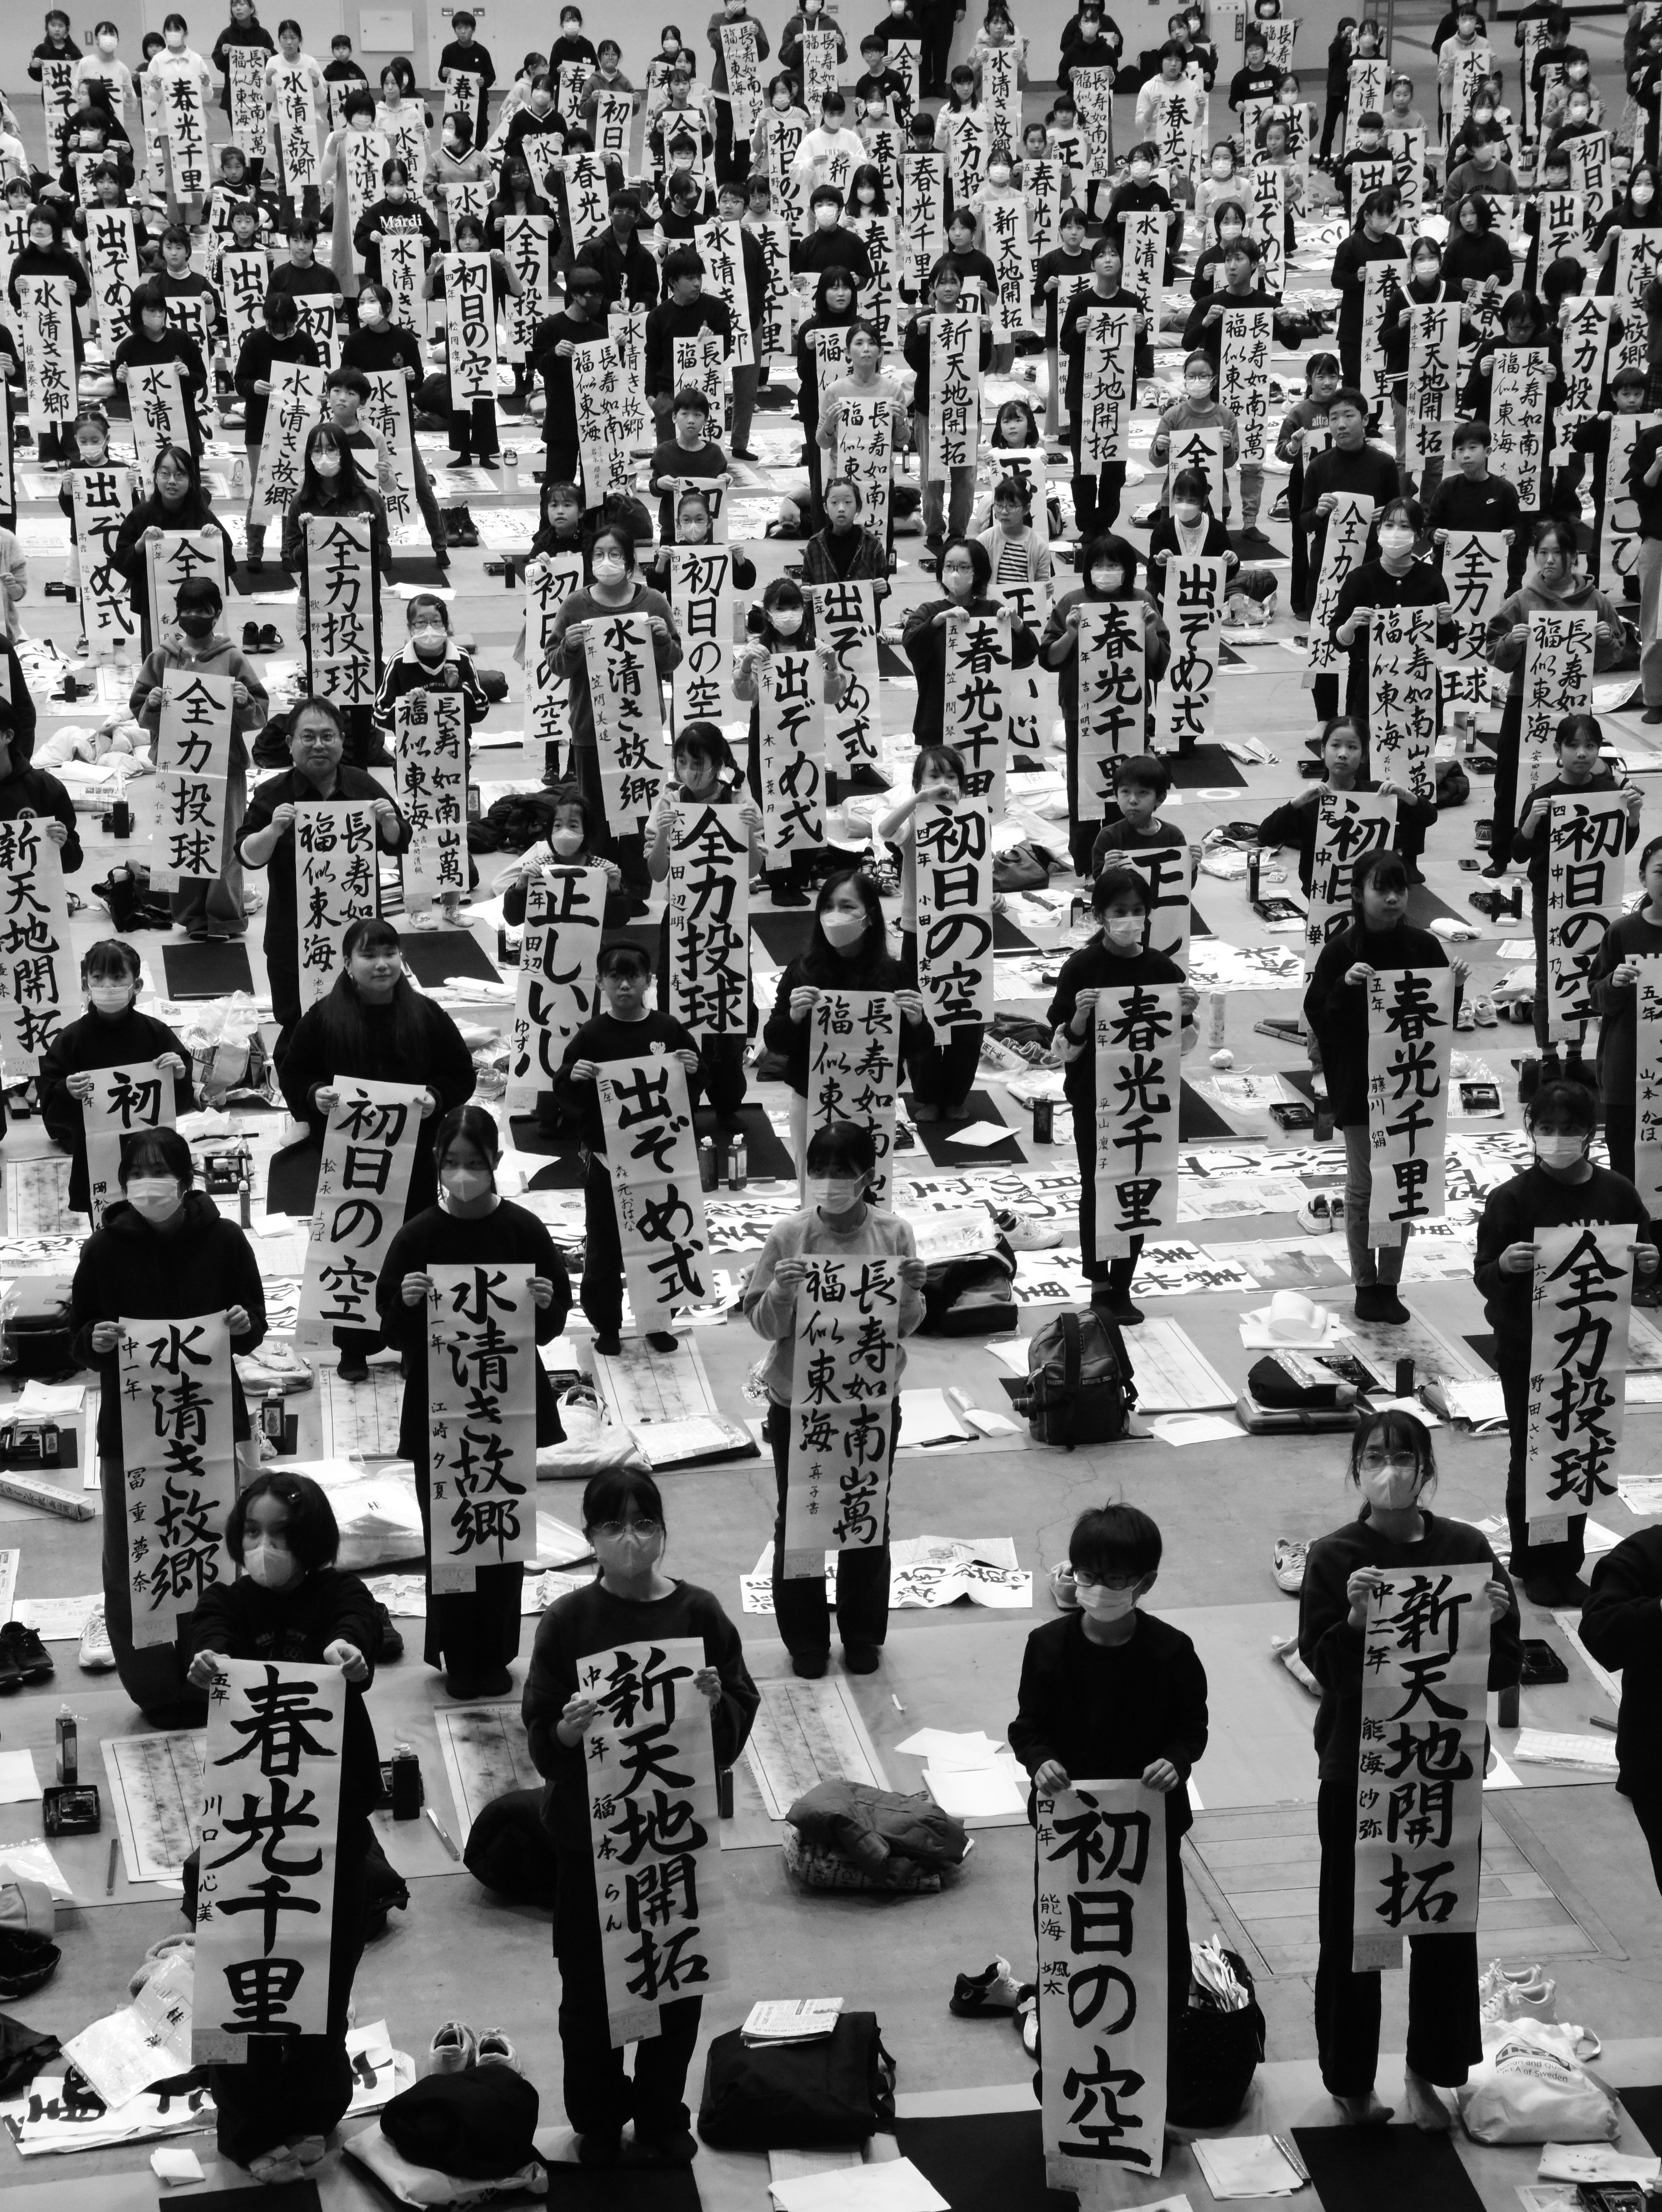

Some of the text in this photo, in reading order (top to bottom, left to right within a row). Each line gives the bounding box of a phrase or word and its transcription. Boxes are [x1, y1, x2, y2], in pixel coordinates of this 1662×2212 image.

[231, 50, 251, 126] 福似東海
[246, 49, 267, 154] 長寿如南山萬
[282, 71, 315, 184] 水清き故郷
[723, 29, 746, 96] 福似東海
[806, 34, 823, 102] 福似東海
[1092, 70, 1108, 177] 長寿如南山萬
[172, 78, 205, 192] 春光千里
[774, 121, 804, 238] 初日の空
[87, 215, 97, 236] 三年
[96, 214, 133, 343] 出ぞめ式
[380, 214, 423, 229] Mardi
[506, 227, 514, 253] 六年
[506, 219, 548, 346] 全力投球
[910, 156, 939, 279] 春光千里
[992, 207, 1024, 329] 新天地開拓
[21, 287, 36, 372] 中一年 後藤
[34, 280, 70, 419] 水清き故郷
[445, 273, 458, 345] 四年 松岡
[451, 258, 494, 398] 初日の空
[1059, 296, 1066, 316] 五年
[1367, 276, 1374, 297] 五年
[1564, 323, 1572, 340] 六年
[128, 383, 139, 414] 中一年
[574, 350, 601, 443] 福似東海
[599, 345, 629, 490] 長寿如南山萬
[620, 319, 646, 441] 水清き故郷
[937, 317, 973, 466] 新天地開拓
[1083, 372, 1093, 399] 田口
[1089, 312, 1129, 460] 新天地開拓
[1221, 313, 1246, 416] 福似東海
[1240, 312, 1270, 460] 長寿如南山萬
[1416, 305, 1449, 456] 新天地開拓
[1493, 353, 1520, 455] 福似東海
[1517, 352, 1545, 506] 長寿如南山萬
[1560, 299, 1607, 446] 全力投球
[74, 480, 84, 502] 三年
[265, 369, 312, 512] 水清き故郷
[1170, 444, 1180, 473] 六年
[84, 472, 135, 636] 出ぞめ式
[153, 542, 165, 561] 六年
[525, 568, 535, 588] 四年
[671, 554, 681, 573] 四年
[1331, 508, 1340, 528] 六年
[1445, 541, 1452, 557] 六年
[307, 528, 322, 679] 六年 歌野 琴子
[316, 522, 374, 704] 全力投球
[532, 565, 579, 741] 初日の空
[584, 623, 605, 707] 中一年 笠間
[678, 552, 729, 721] 初日の空
[814, 596, 825, 615] 三年
[945, 625, 959, 714] 五年 笠間
[1170, 563, 1222, 735] 出ぞめ式
[1442, 534, 1501, 704] 全力投球
[161, 685, 173, 709] 六年
[603, 618, 664, 814] 水清き故郷
[761, 657, 777, 814] 三年 木下 葉月
[824, 582, 878, 762] 出ぞめ式
[1080, 619, 1092, 738] 五年 吉川 明里
[1372, 613, 1405, 753] 福似東海
[1403, 610, 1434, 801] 長寿如南山萬
[1524, 618, 1562, 744] 福似東海
[155, 760, 170, 793] 浦崎
[168, 677, 227, 875] 全力投球
[397, 697, 433, 832] 福似東海
[431, 697, 464, 887] 長寿如南山萬
[773, 655, 824, 849] 出ぞめ式
[297, 812, 342, 972] 福似東海
[670, 810, 688, 912] 六年 田辺
[917, 828, 932, 926] 四年 小田
[1310, 794, 1339, 900] 四年 中村
[1548, 805, 1566, 909] 四年 中村
[1553, 803, 1626, 1022] 初日の空
[0, 819, 63, 1053] 新天地開拓
[521, 936, 542, 974] 田辺
[672, 805, 749, 1034] 全力投球
[916, 804, 993, 1028] 初日の空
[599, 1078, 615, 1105] 三年
[1097, 1020, 1110, 1130] 五年 平山
[1110, 985, 1173, 1232] 春光千里
[1369, 977, 1387, 1116] 五年 藤川
[1384, 970, 1449, 1221] 春光千里
[1640, 985, 1660, 1142] 五年 山本 かほ
[93, 1181, 109, 1212] 岡松
[318, 1157, 337, 1196] 松永
[319, 1088, 408, 1323] 初日の空
[610, 1065, 706, 1305] 出ぞめ式
[429, 1287, 449, 1501] 中一年 江崎 夕夏
[447, 1266, 528, 1563] 水清き故郷
[799, 1260, 846, 1453] 福似東海
[833, 1259, 897, 1544] 長寿如南山萬
[1528, 1263, 1549, 1462] 六年 野田 さき
[1543, 1229, 1629, 1507] 全力投球
[121, 1336, 152, 1593] 中一年 夢奈
[145, 1324, 224, 1612] 水清き故郷
[1365, 1581, 1394, 1676] 中二年
[197, 1672, 231, 1924] 五年 川口 心美
[1359, 1715, 1387, 1776] 能海
[1374, 1574, 1474, 1929] 新天地開拓
[205, 1663, 339, 2037] 春光千里
[591, 1796, 622, 1933] 福本 らん
[596, 1646, 711, 2002] 新天地開拓
[1035, 1799, 1067, 1941] 四年 能海
[1045, 1788, 1152, 2168] 初日の空
[1534, 2070, 1568, 2083] Sweden
